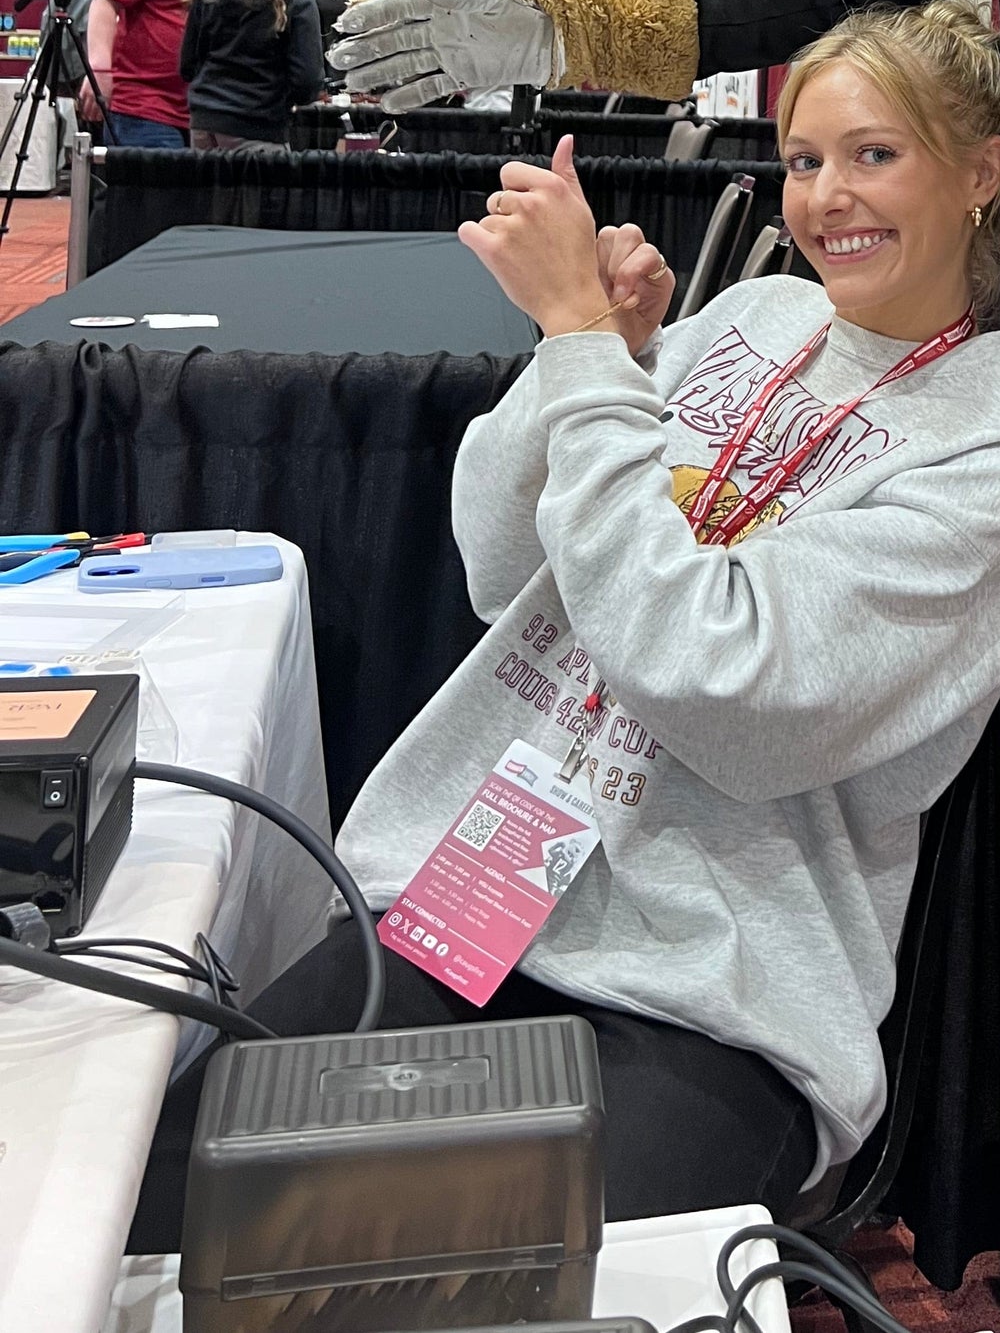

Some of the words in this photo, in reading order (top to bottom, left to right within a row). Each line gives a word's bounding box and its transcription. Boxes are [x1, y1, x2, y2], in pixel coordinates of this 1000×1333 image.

[522, 614, 558, 654] 92
[601, 766, 647, 807] 23
[481, 787, 499, 803] FULL
[497, 796, 533, 823] BROCHURE
[531, 817, 541, 827] &
[538, 821, 557, 837] MAP
[483, 864, 507, 883] AGENDA
[551, 857, 568, 875] 12
[400, 896, 416, 910] STAY
[413, 904, 447, 930] CONNECTED
